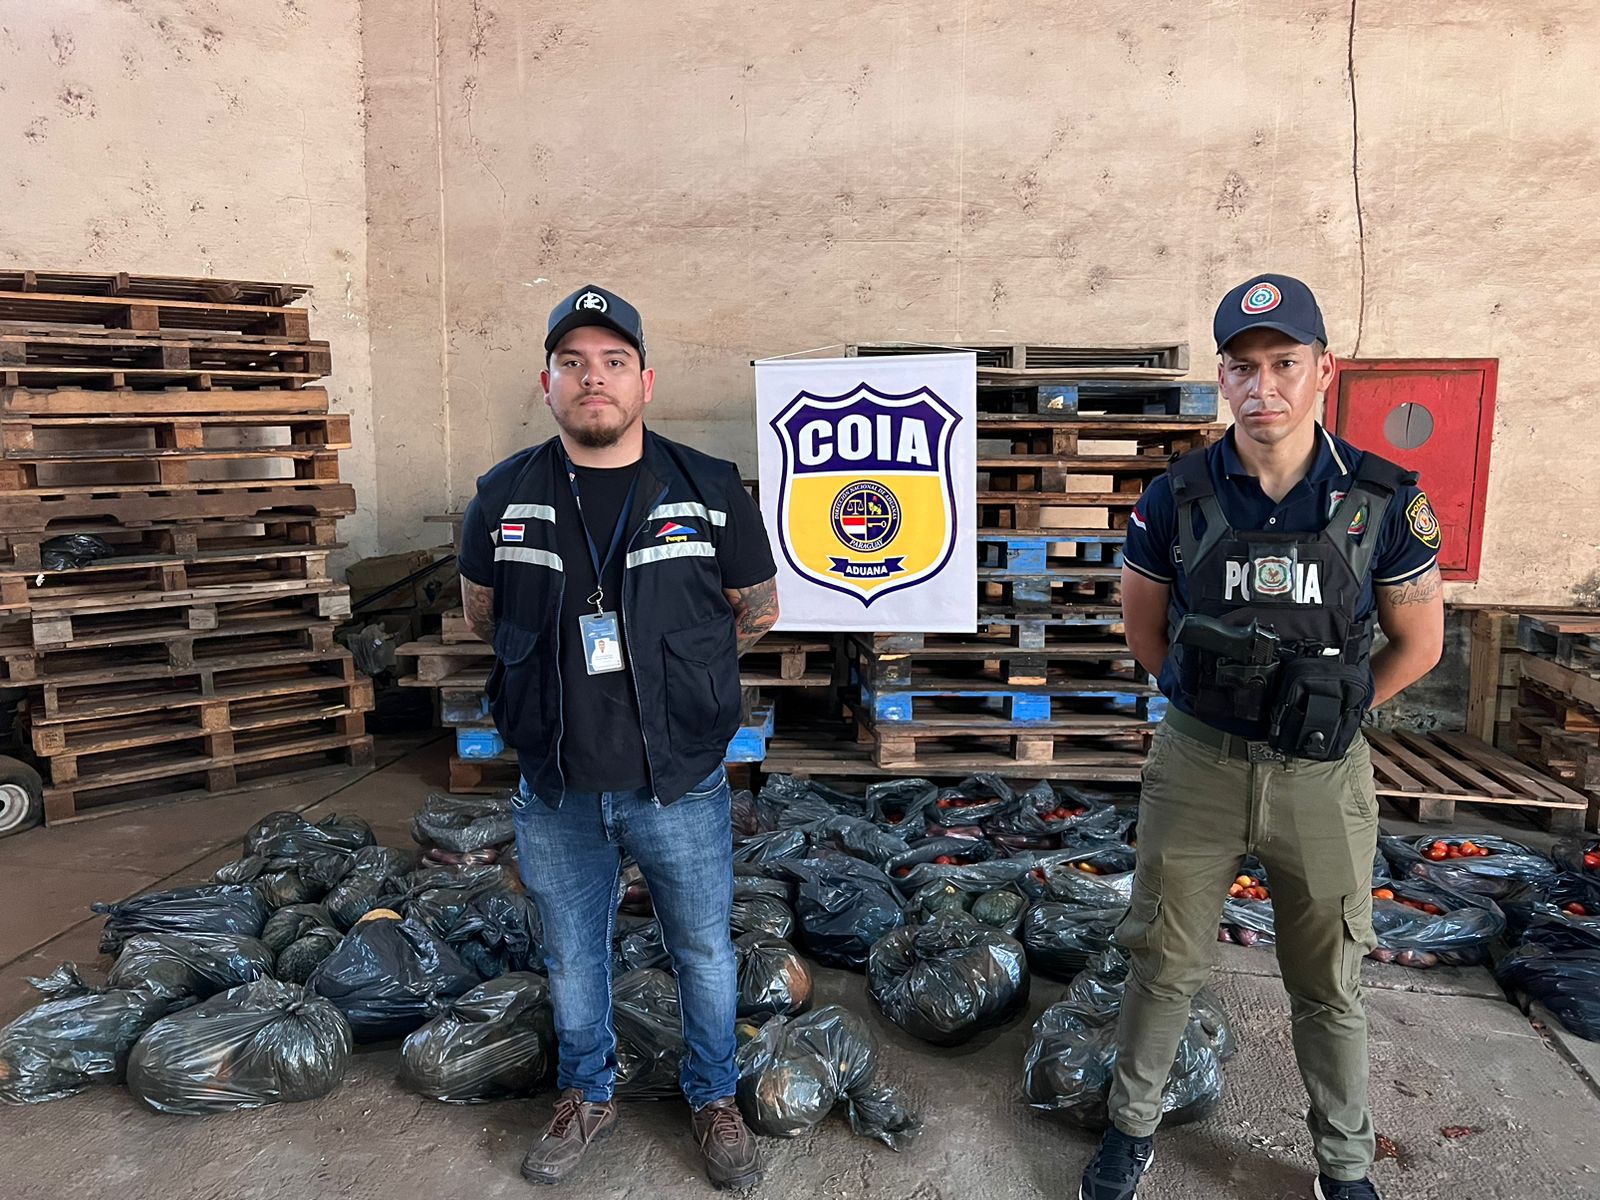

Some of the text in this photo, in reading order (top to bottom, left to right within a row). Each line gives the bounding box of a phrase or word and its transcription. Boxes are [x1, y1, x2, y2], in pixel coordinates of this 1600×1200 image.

[798, 414, 932, 466] COIA
[849, 483, 878, 494] NACIONAL
[884, 494, 898, 520] ADUANAS
[849, 538, 884, 550] PARAGUAY
[845, 565, 888, 576] ADUANA
